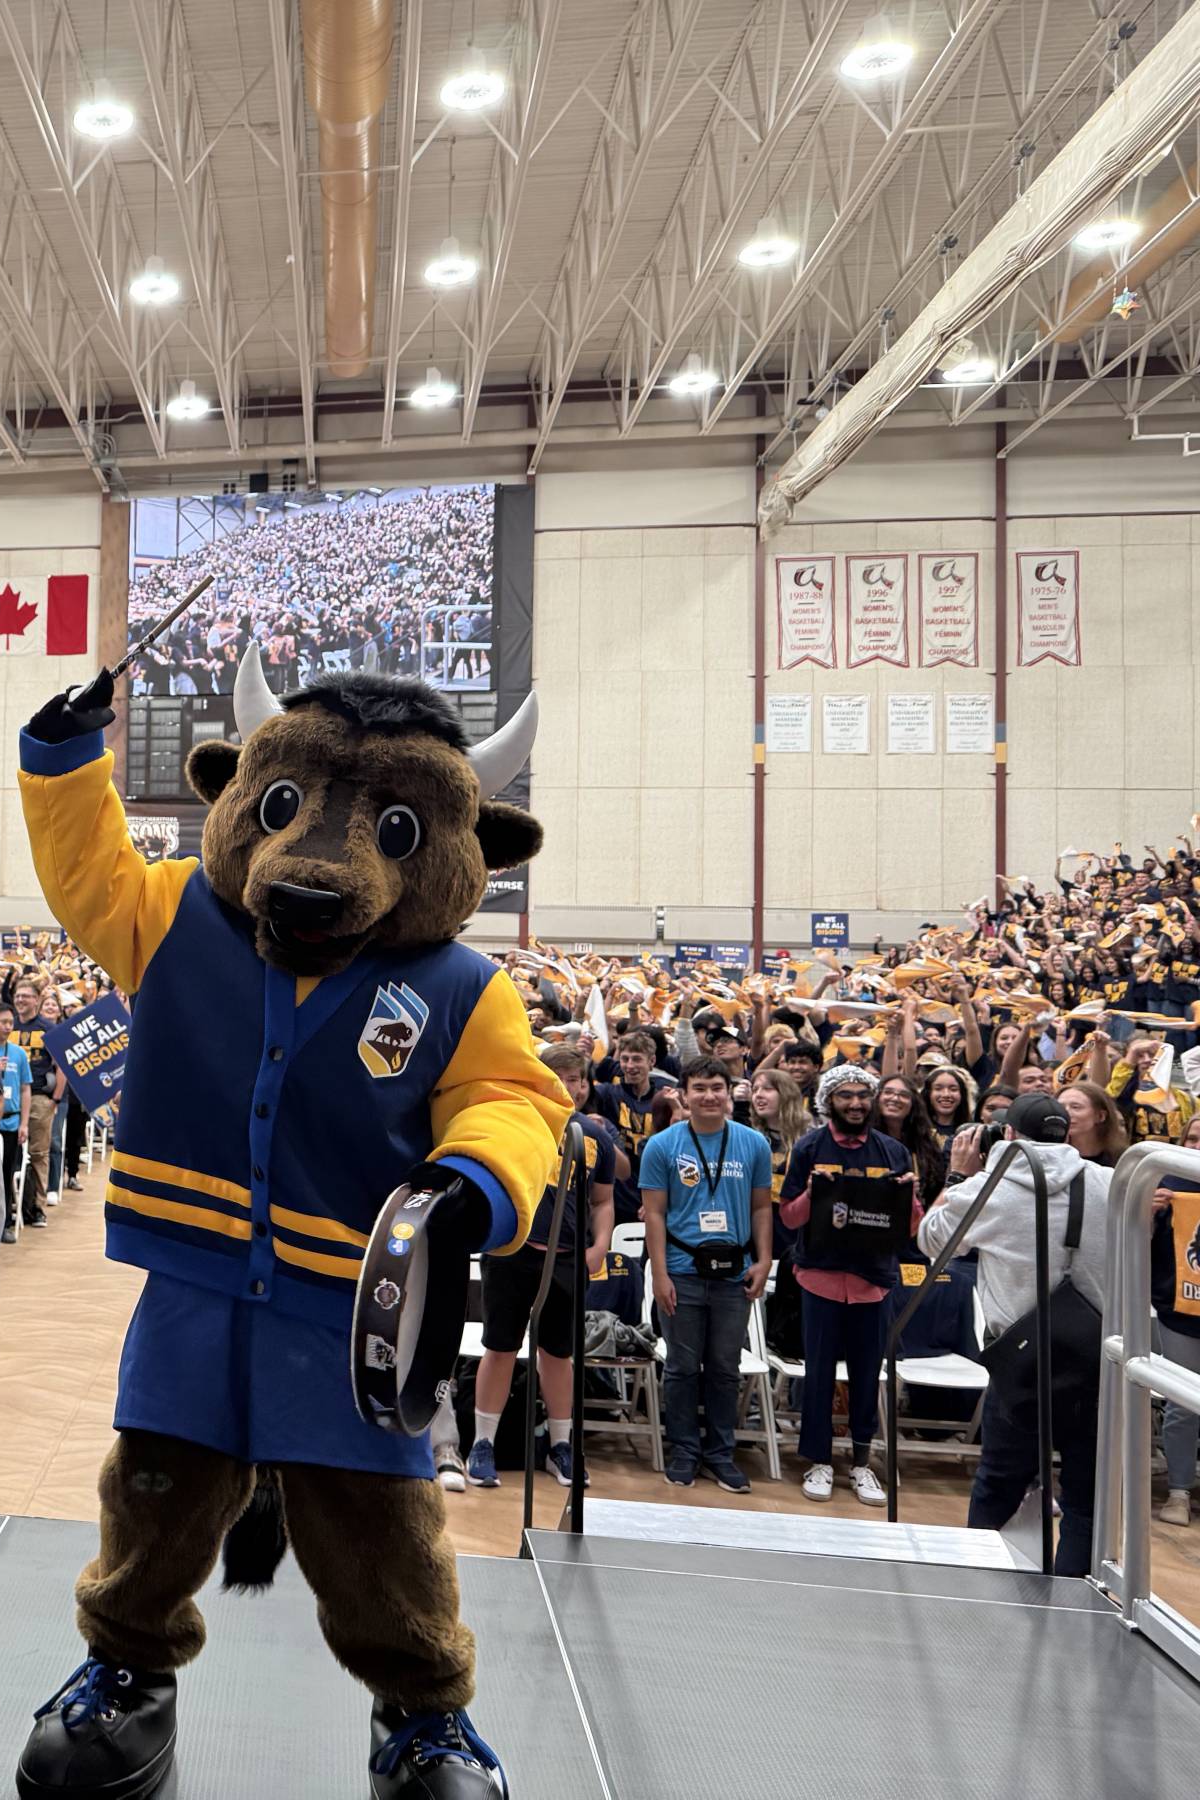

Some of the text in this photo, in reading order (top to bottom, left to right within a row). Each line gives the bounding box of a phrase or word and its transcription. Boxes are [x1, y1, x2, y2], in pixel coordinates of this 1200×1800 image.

[867, 589, 888, 597] 1996
[938, 586, 960, 594] 1997
[1031, 587, 1066, 595] 1975-76
[789, 592, 823, 600] 1987-88
[863, 604, 893, 612] WOMEN'S
[932, 605, 964, 613] WOMEN'S
[928, 648, 968, 656] CHAMPIONS
[128, 822, 180, 854] SONS
[72, 1014, 100, 1038] WE
[64, 1019, 127, 1065] ARE ALL
[74, 1033, 130, 1077] BISONS
[849, 1209, 890, 1221] University
[853, 1217, 890, 1228] Manitoba
